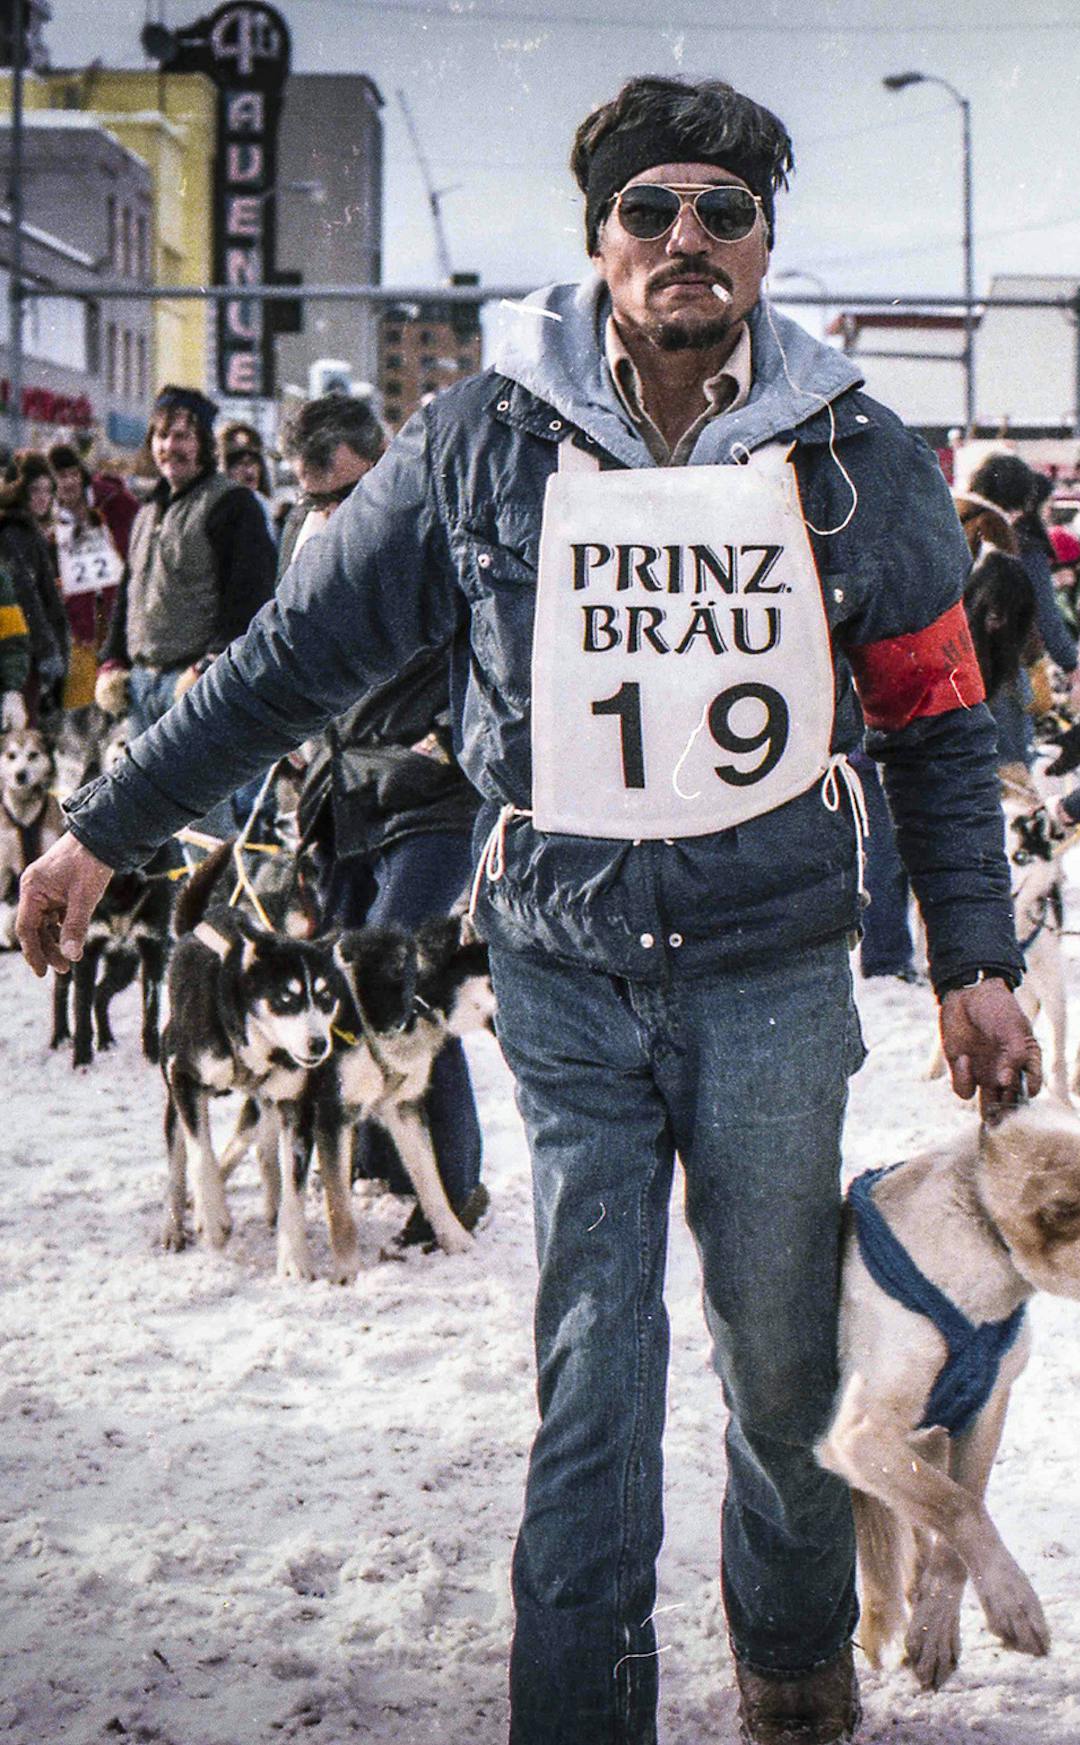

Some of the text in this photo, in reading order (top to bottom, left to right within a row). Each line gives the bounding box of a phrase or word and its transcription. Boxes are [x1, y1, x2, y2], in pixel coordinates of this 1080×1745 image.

[227, 91, 264, 392] AVENUE
[71, 557, 111, 583] 22
[581, 600, 781, 655] BRÄU
[591, 681, 790, 789] 19
